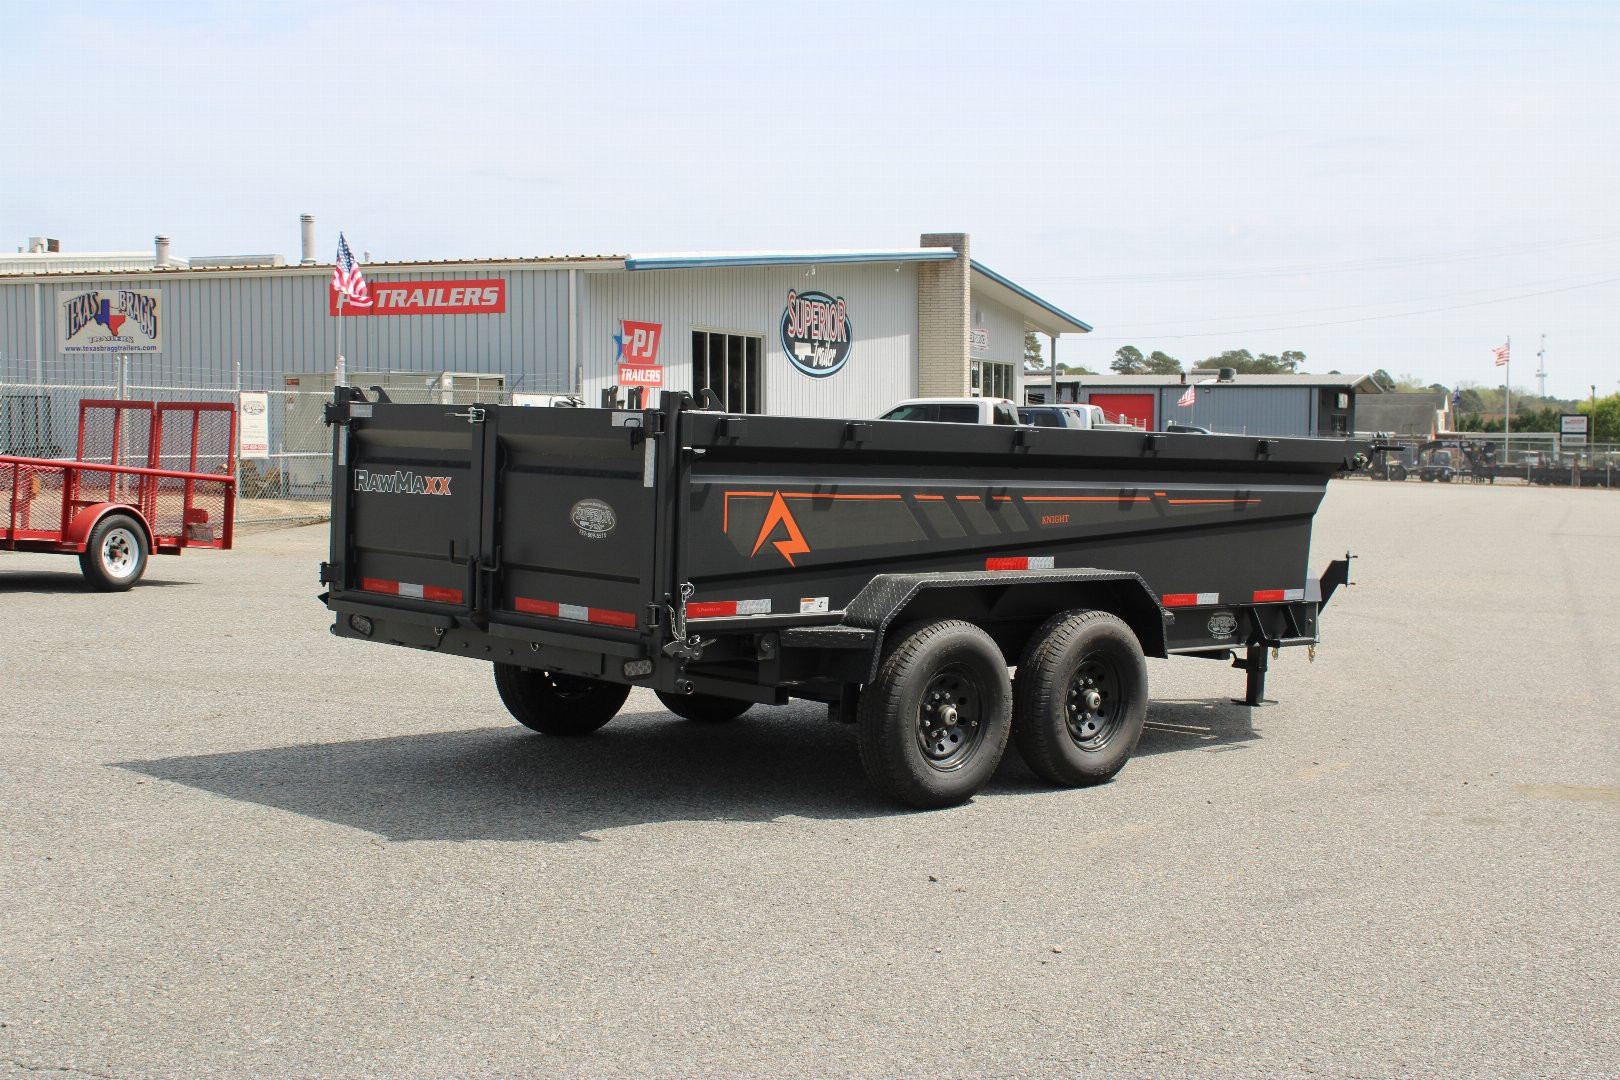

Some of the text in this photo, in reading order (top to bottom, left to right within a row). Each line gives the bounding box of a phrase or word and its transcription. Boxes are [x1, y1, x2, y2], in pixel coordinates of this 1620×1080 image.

[376, 287, 499, 308] TRAILERS
[63, 291, 157, 340] TEXAS BRAGG
[788, 290, 847, 342] SUPERIOR
[65, 345, 157, 353] www.texasbraggtrailers.com
[632, 329, 655, 357] PJ
[621, 368, 661, 382] TRAILERS
[1041, 514, 1069, 525] KNIGHT
